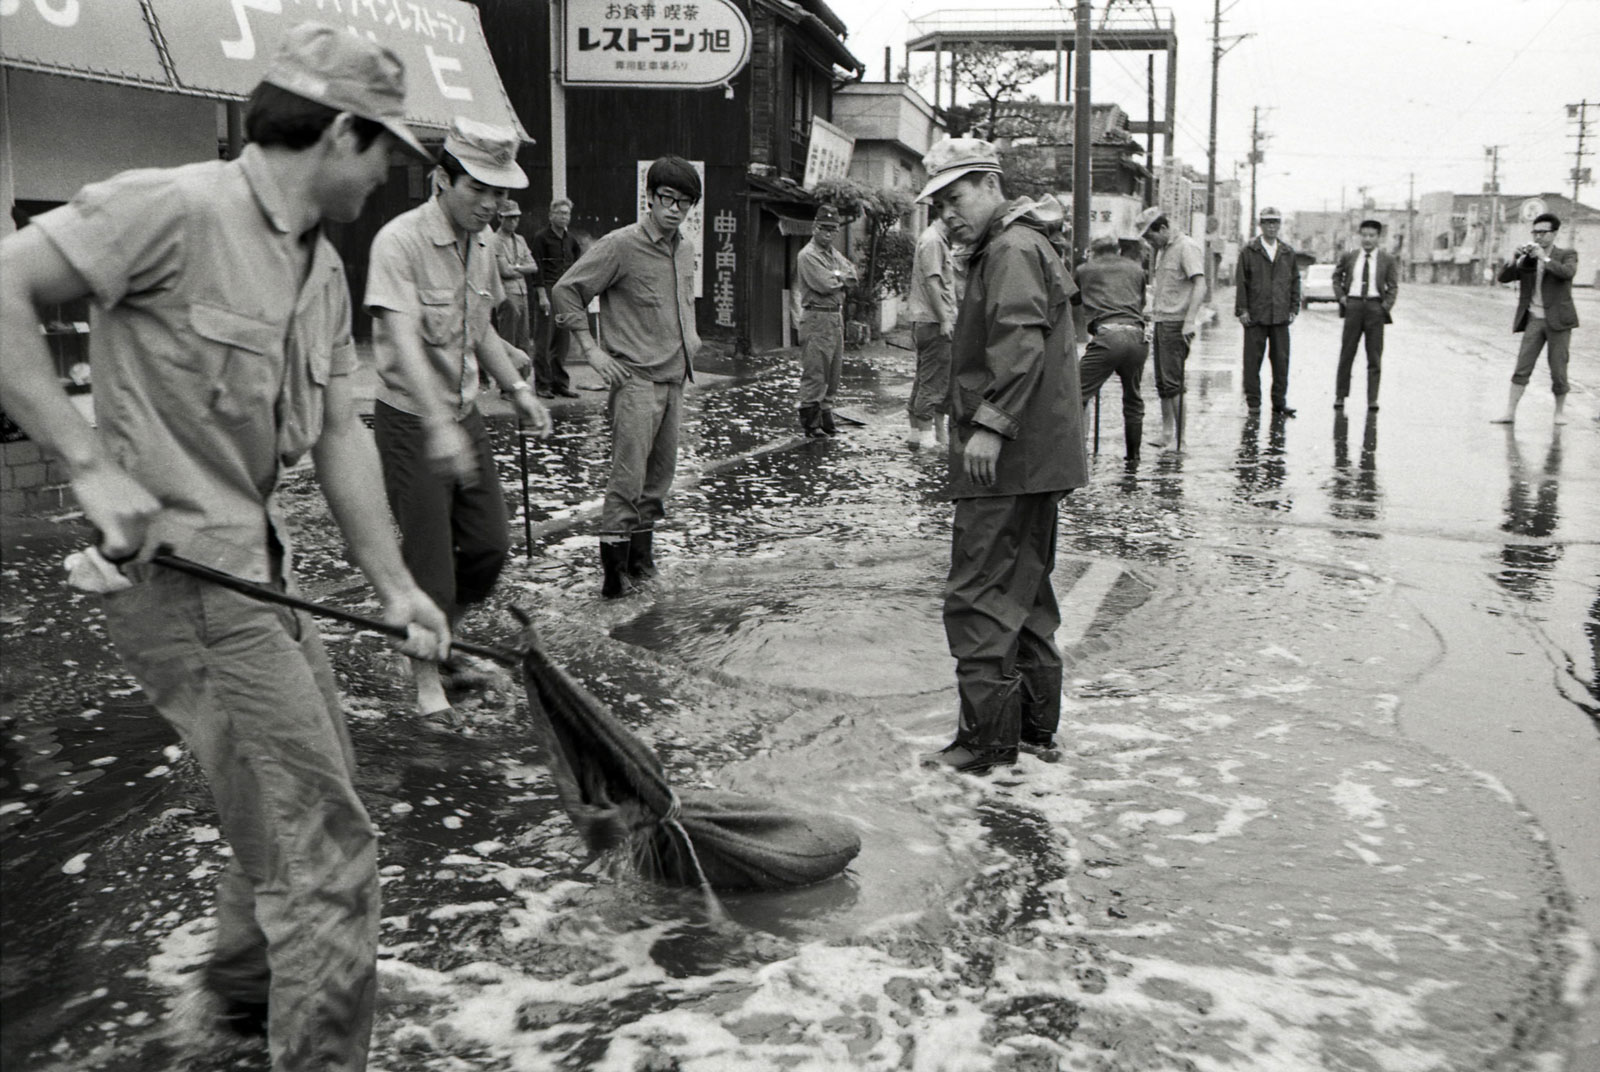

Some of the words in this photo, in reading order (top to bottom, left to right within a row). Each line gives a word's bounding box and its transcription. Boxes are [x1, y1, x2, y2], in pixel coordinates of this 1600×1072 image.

[605, 4, 656, 20] お食事
[664, 4, 699, 20] 喫茶
[578, 27, 731, 53] レストラン旭
